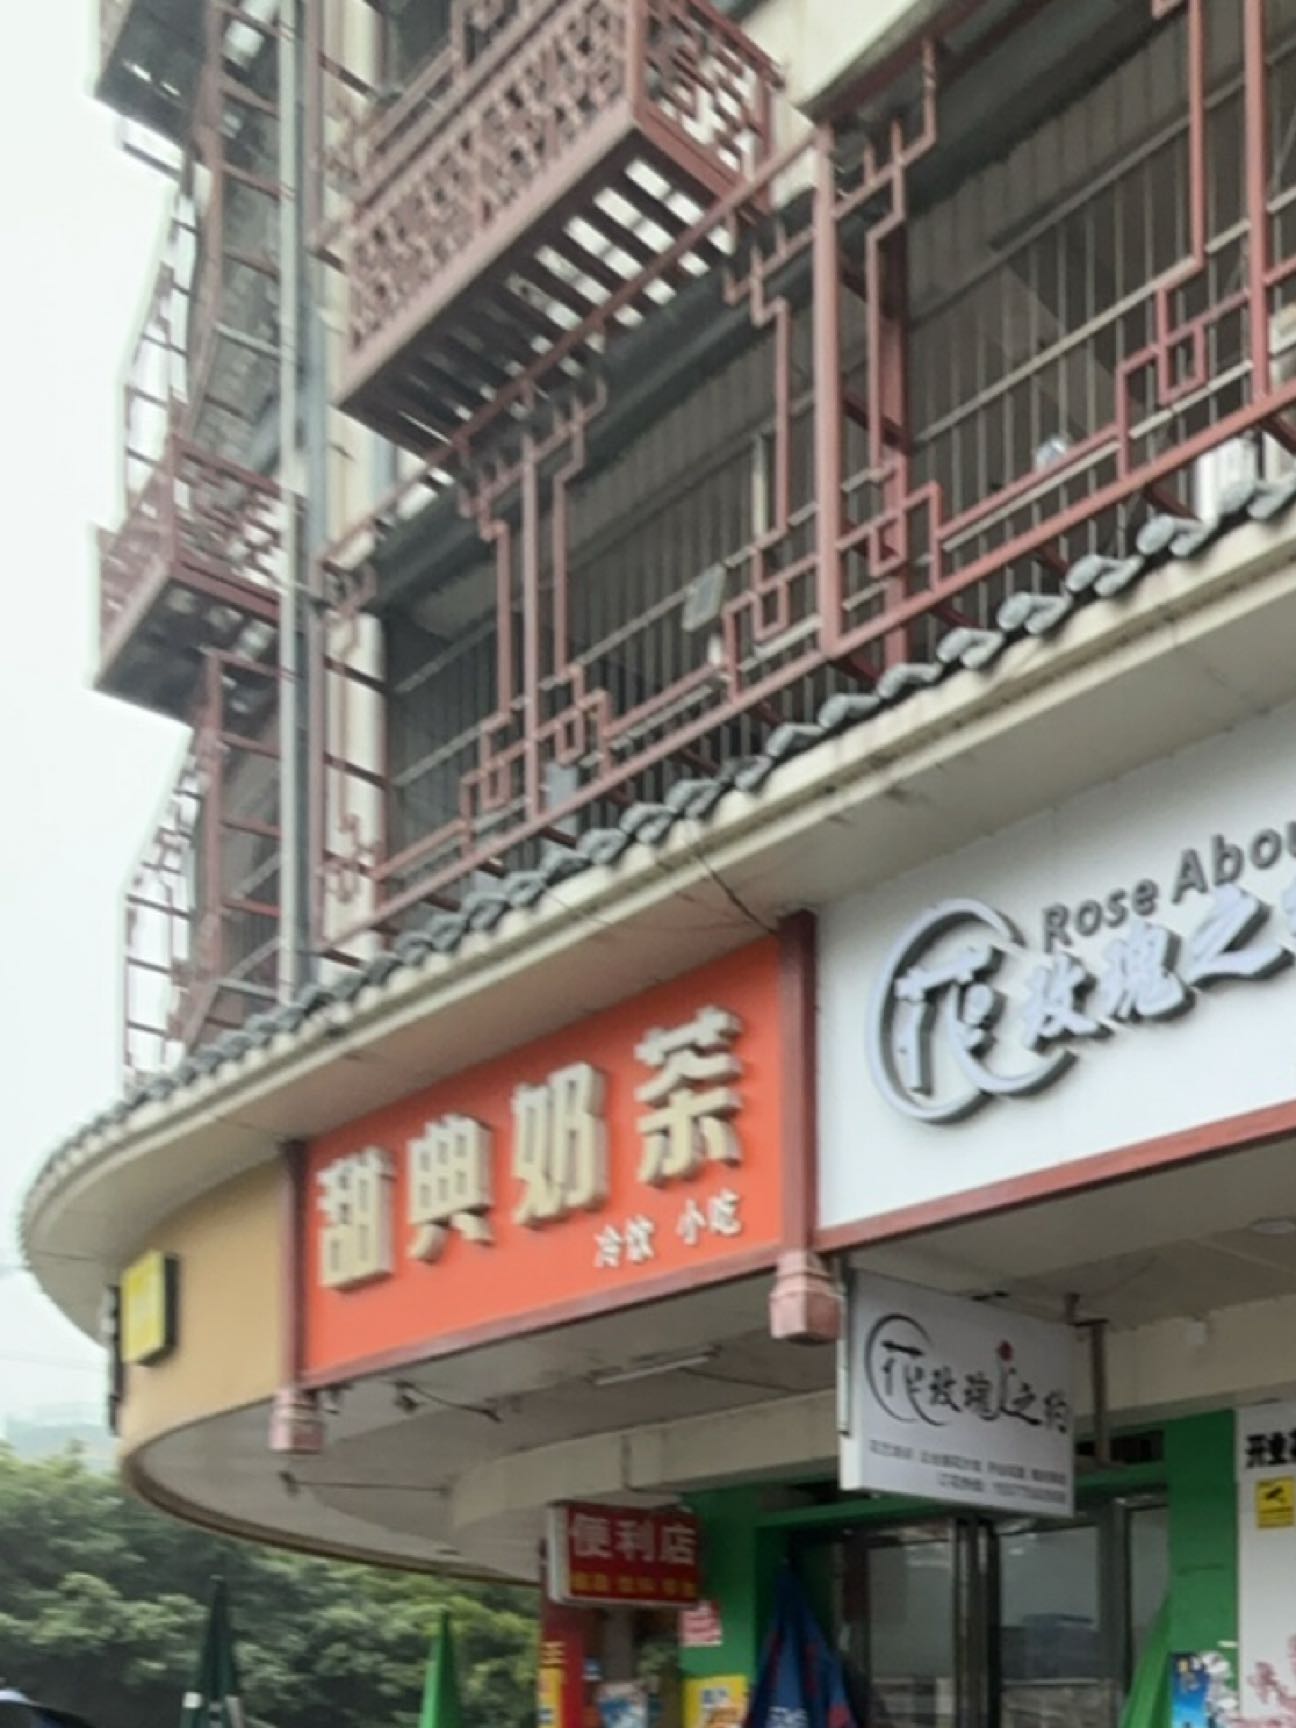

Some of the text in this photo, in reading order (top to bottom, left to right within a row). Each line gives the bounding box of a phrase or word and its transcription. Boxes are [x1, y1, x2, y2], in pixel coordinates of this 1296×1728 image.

[1042, 879, 1159, 953] Rose
[569, 1512, 697, 1566] 便利店
